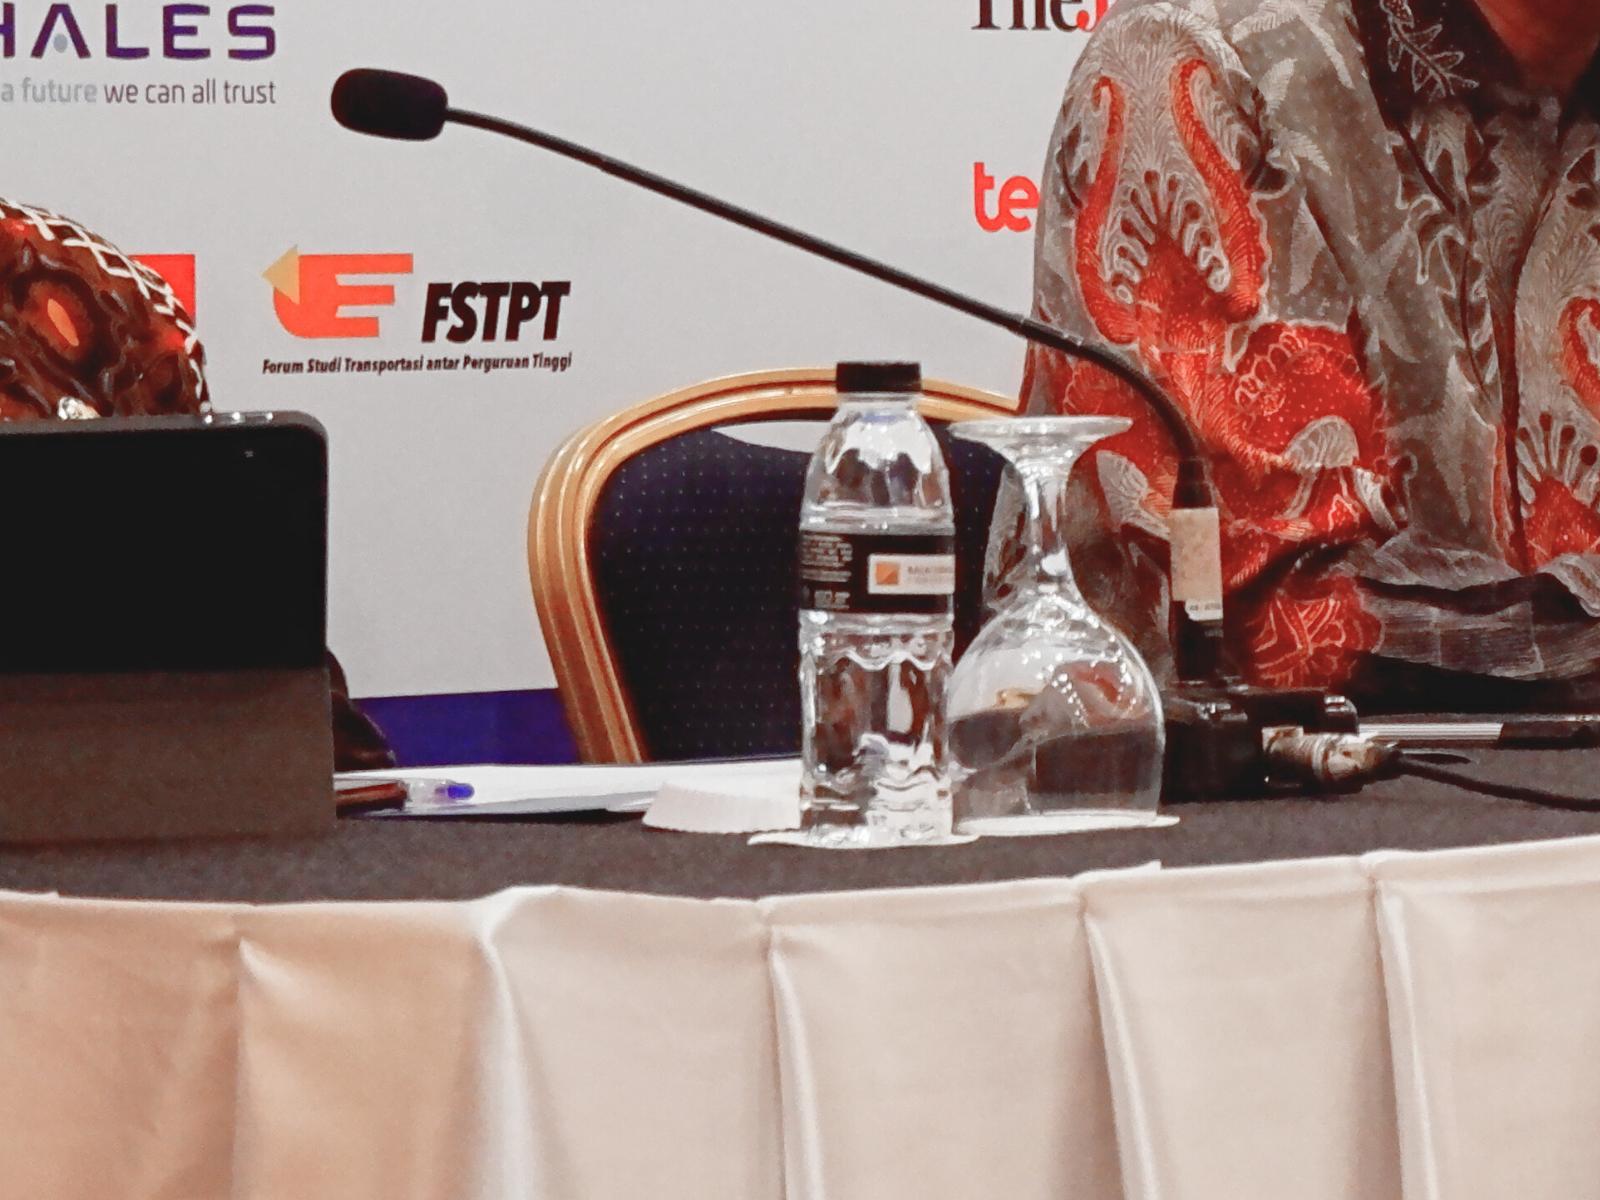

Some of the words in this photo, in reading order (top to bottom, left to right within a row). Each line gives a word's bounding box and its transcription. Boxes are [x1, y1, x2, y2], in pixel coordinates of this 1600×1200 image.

[0, 83, 15, 103] a
[21, 77, 98, 104] future
[104, 84, 139, 104] we
[145, 84, 185, 104] can
[192, 79, 216, 104] all
[224, 80, 276, 104] trust
[421, 281, 571, 343] FSTPT
[262, 359, 303, 374] Forum
[307, 356, 342, 373] Studi
[345, 355, 424, 376] Transportasi
[426, 356, 460, 371] antar
[462, 354, 530, 374] Perguruan
[532, 351, 573, 374] Tinggi
